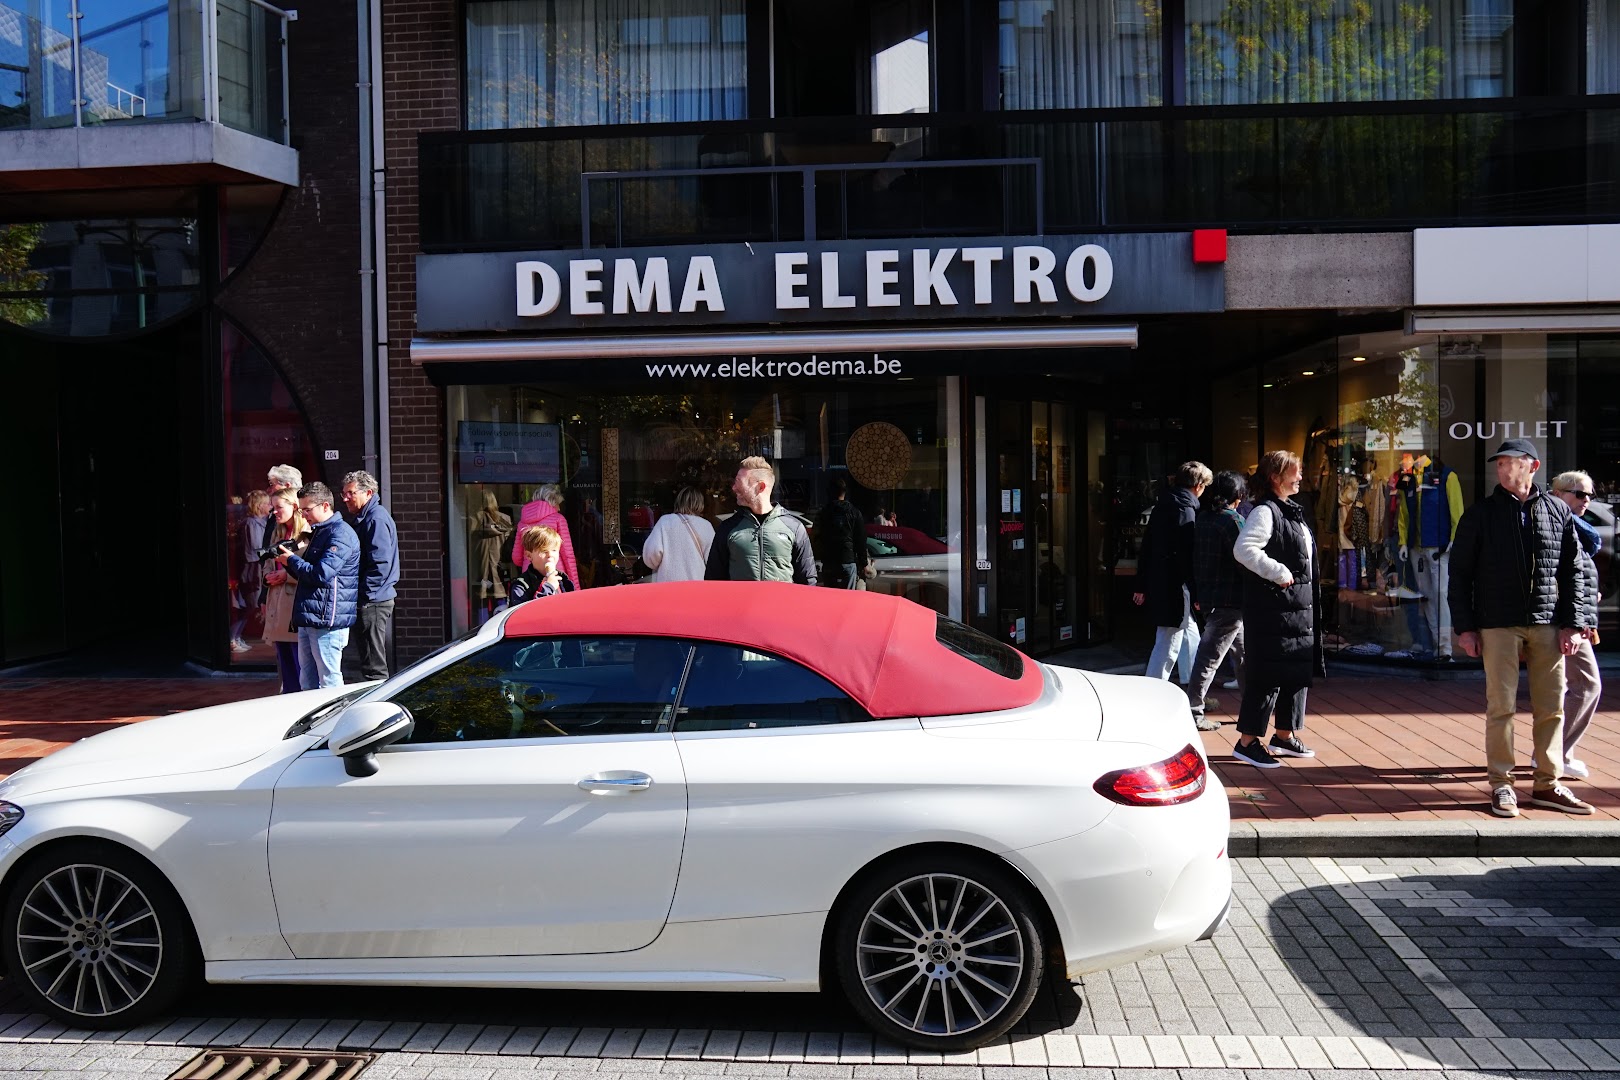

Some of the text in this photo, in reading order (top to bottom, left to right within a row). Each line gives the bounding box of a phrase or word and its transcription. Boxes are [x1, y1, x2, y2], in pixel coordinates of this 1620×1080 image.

[516, 244, 1115, 317] DEMA ELEKTRO
[645, 353, 903, 378] www.elektrodema.be
[528, 429, 552, 438] socials
[1448, 420, 1568, 440] OUTLET
[326, 451, 337, 459] 204
[874, 532, 902, 540] SAMSUNG
[978, 561, 990, 569] 202
